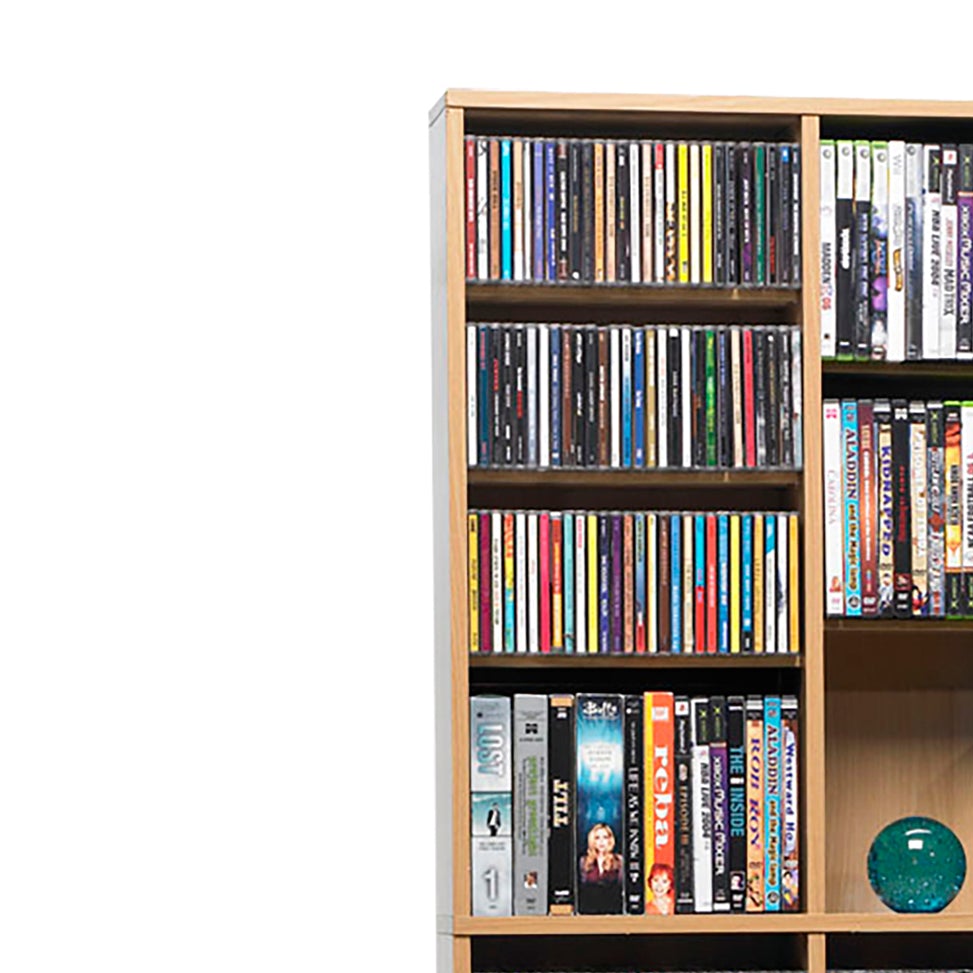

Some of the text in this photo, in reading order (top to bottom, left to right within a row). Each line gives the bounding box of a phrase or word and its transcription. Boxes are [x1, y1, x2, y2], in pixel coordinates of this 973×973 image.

[846, 428, 859, 499] ALADDIN
[882, 445, 892, 557] KIDNAPPED
[475, 723, 505, 777] LOST
[730, 745, 744, 837] THE INSIDE
[767, 724, 779, 796] ALADDIN
[653, 744, 672, 850] reba
